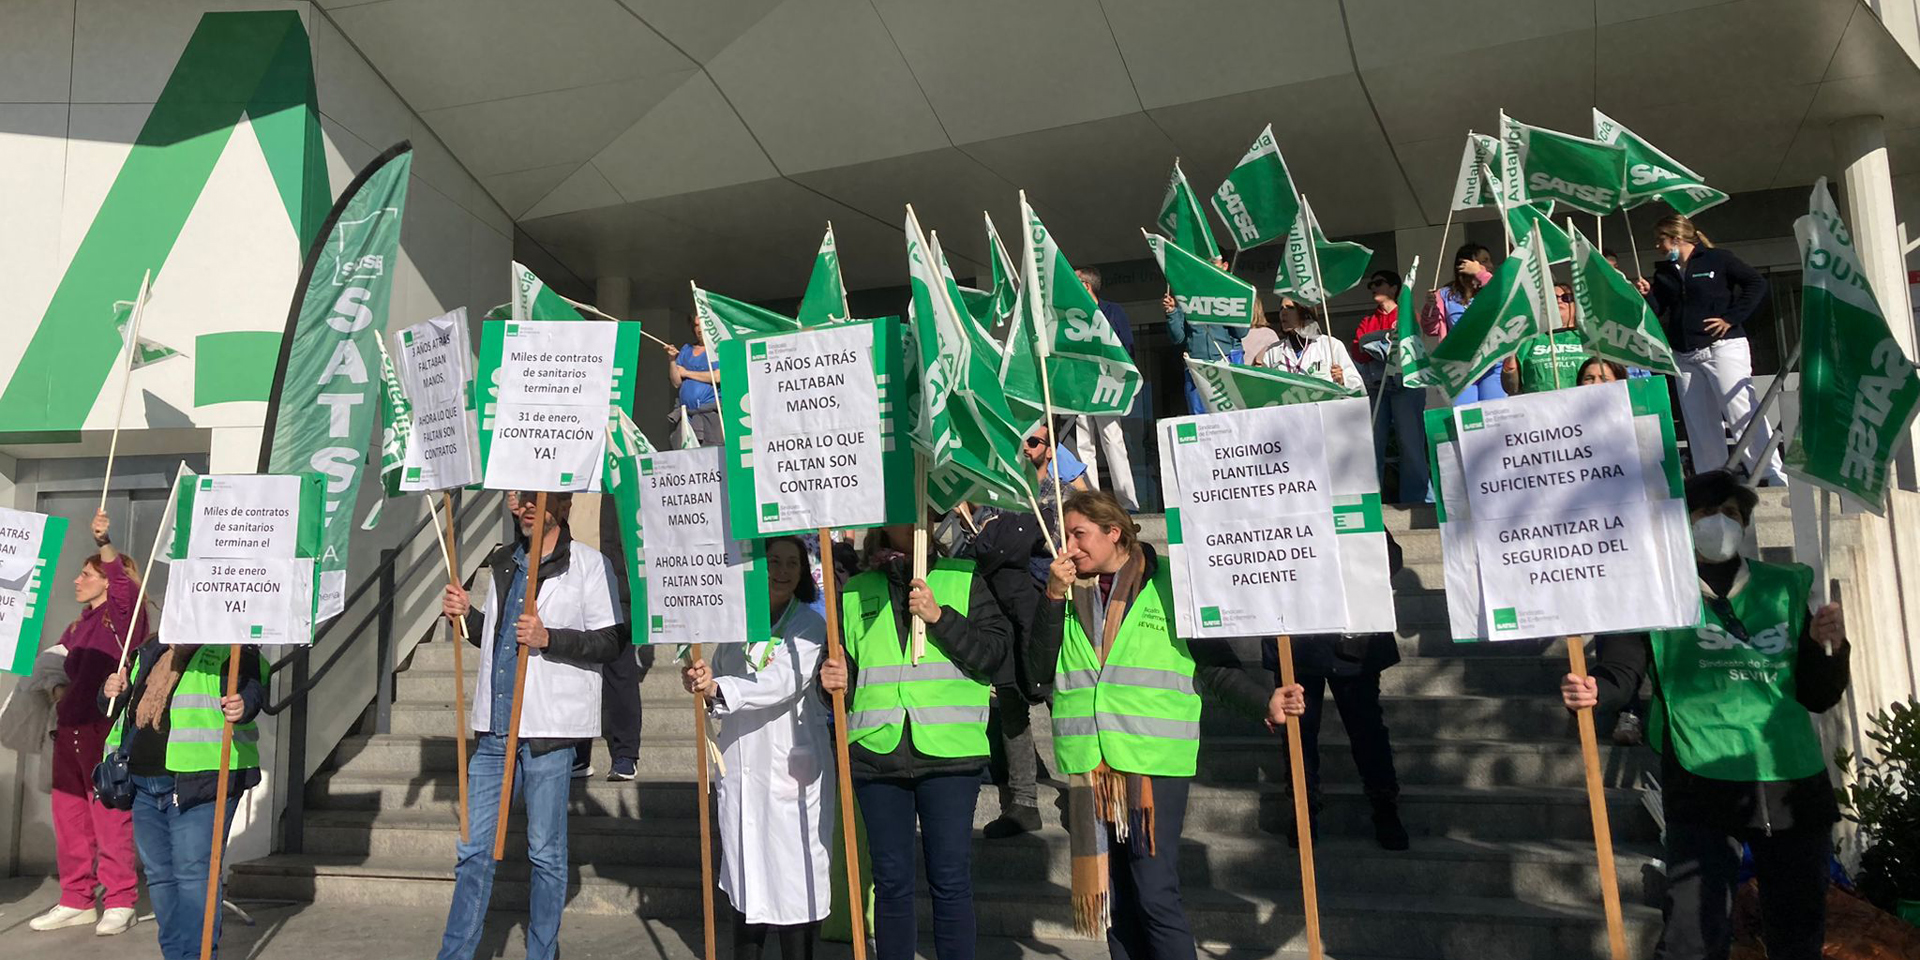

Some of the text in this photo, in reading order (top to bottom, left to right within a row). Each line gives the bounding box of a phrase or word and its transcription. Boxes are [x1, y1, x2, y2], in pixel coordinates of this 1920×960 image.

[1529, 172, 1615, 208] SATSE
[1218, 179, 1260, 242] SATSE
[1174, 295, 1247, 317] SATSE
[511, 352, 603, 363] Miles de contratos
[765, 362, 771, 374] 3
[775, 356, 810, 372] AÑOS
[815, 350, 857, 367] ATRÁS
[523, 367, 586, 378] de sanitarios
[525, 383, 581, 394] terminan el
[778, 374, 844, 392] FALTABAN
[787, 396, 840, 412] MANOS,
[519, 412, 580, 424] 31 de enero,
[499, 426, 593, 441] ¡CONTRATACIÓN
[767, 432, 865, 453] AHORA LO QUE
[1505, 425, 1583, 447] EXIGIMOS
[534, 447, 556, 460] YA!
[1215, 441, 1281, 460] EXIGIMOS
[1503, 446, 1593, 469] PLANTILLAS
[777, 454, 857, 473] FALTAN SON
[1212, 461, 1290, 480] PLANTILLAS
[651, 470, 722, 488] 3 AÑOS ATRÁS
[780, 475, 858, 493] CONTRATOS
[1480, 464, 1624, 494] SUFICIENTES PARA
[662, 492, 712, 506] FALTABAN
[1193, 480, 1316, 503] SUFICIENTES PARA
[204, 506, 289, 517] Miles de contratos
[668, 513, 709, 526] MANOS,
[214, 522, 274, 532] de sanitarios
[1206, 525, 1313, 546] GARANTIZAR LA
[1499, 516, 1624, 543] GARANTIZAR LA
[215, 538, 269, 548] terminan el
[1502, 539, 1628, 565] SEGURIDAD DEL
[655, 552, 729, 568] AHORA LO QUE
[1208, 547, 1316, 567] SEGURIDAD DEL
[212, 566, 266, 576] 31 de enero
[662, 573, 723, 587] FALTAN SON
[1232, 570, 1297, 586] PACIENTE
[1530, 564, 1606, 584] PACIENTE
[192, 580, 280, 593] ¡CONTRATACIÓN
[225, 600, 246, 613] YA!
[664, 594, 723, 607] CONTRATOS
